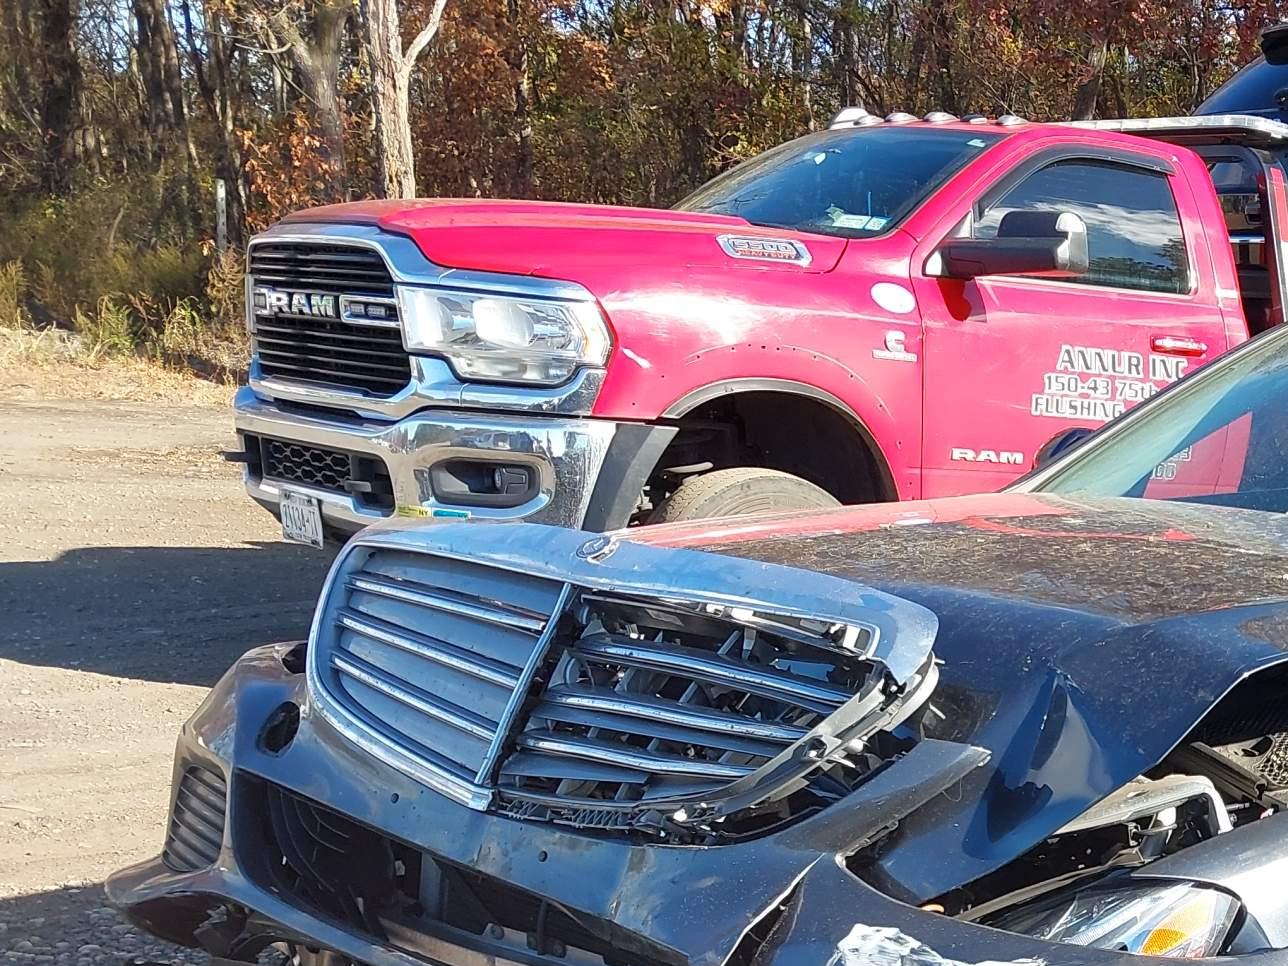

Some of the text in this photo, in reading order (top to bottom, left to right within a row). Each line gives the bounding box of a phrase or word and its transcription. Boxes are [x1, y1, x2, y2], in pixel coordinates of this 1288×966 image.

[270, 291, 336, 317] RAM
[1058, 346, 1142, 376] ANNUR
[1046, 374, 1111, 396] 150-43
[1034, 396, 1123, 419] FLUSHING
[951, 447, 1024, 465] RAM
